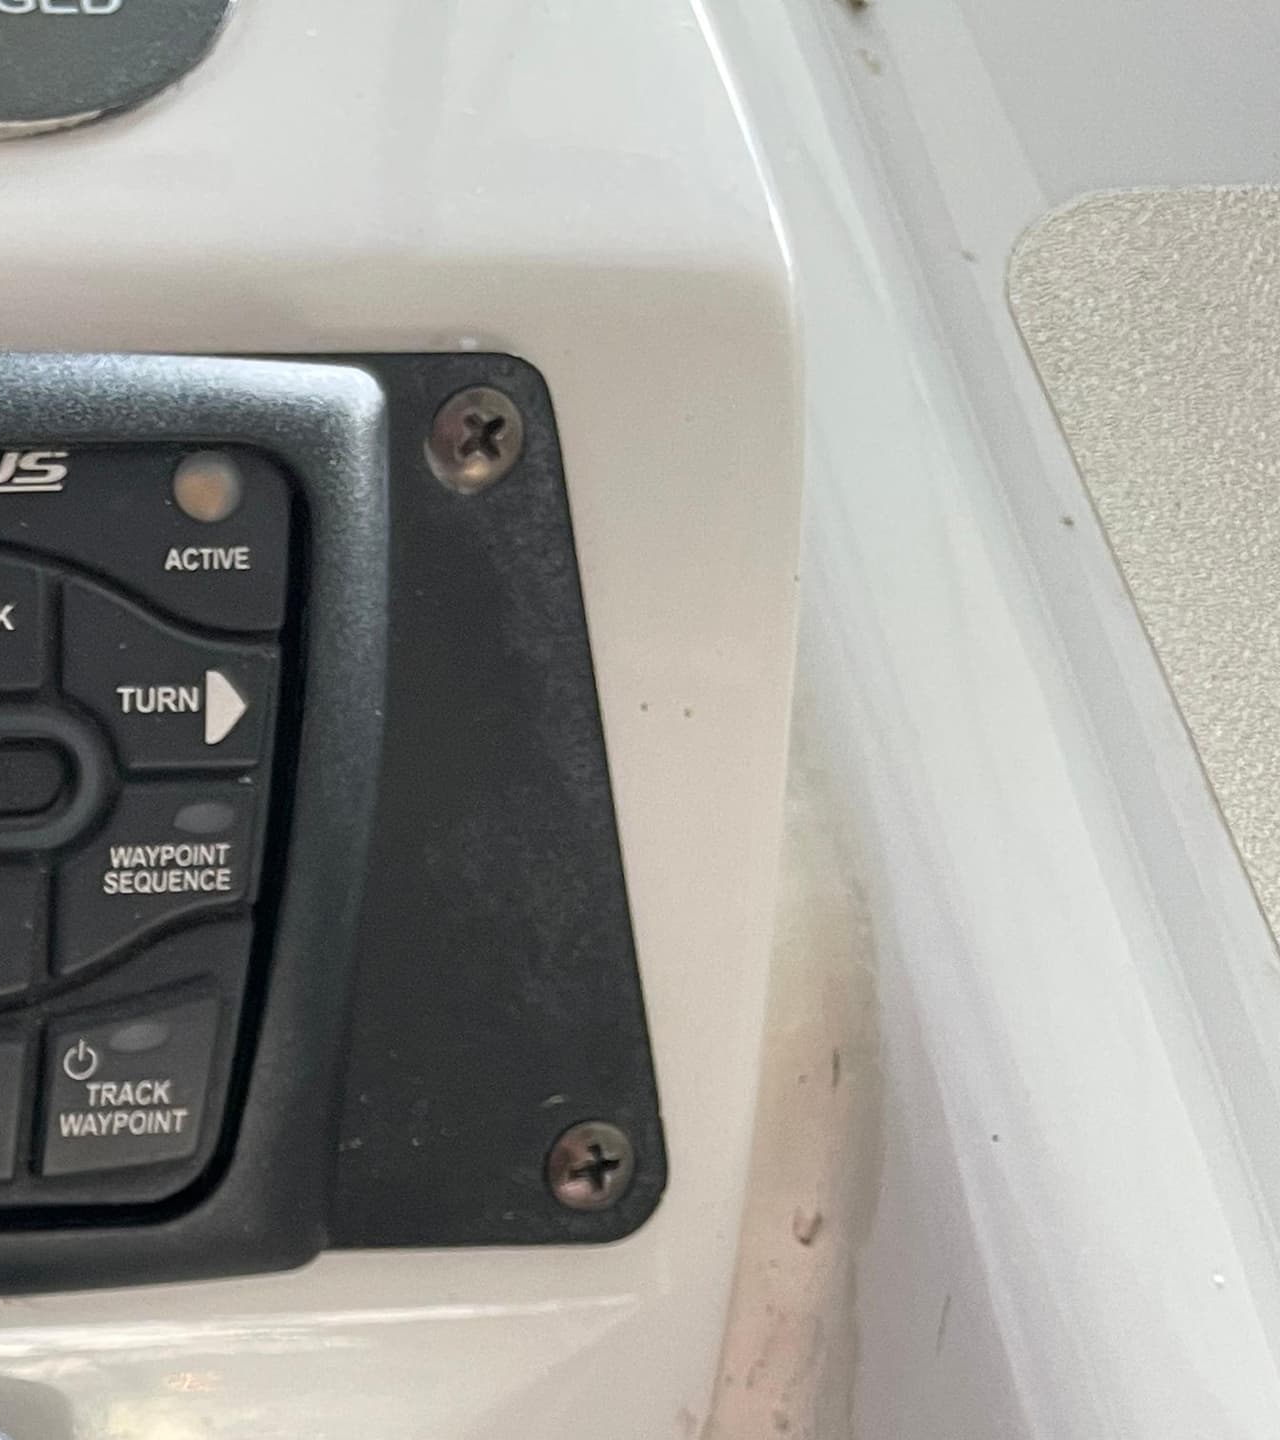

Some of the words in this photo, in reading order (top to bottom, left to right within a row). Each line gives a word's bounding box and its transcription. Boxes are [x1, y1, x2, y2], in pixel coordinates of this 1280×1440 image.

[164, 547, 251, 572] ACTIVE
[116, 686, 199, 715] TURN
[109, 843, 231, 870] WAYPOINT
[103, 868, 232, 896] SEQUENCE
[86, 1080, 171, 1107] TRACK
[59, 1108, 188, 1138] WAYPOINT
